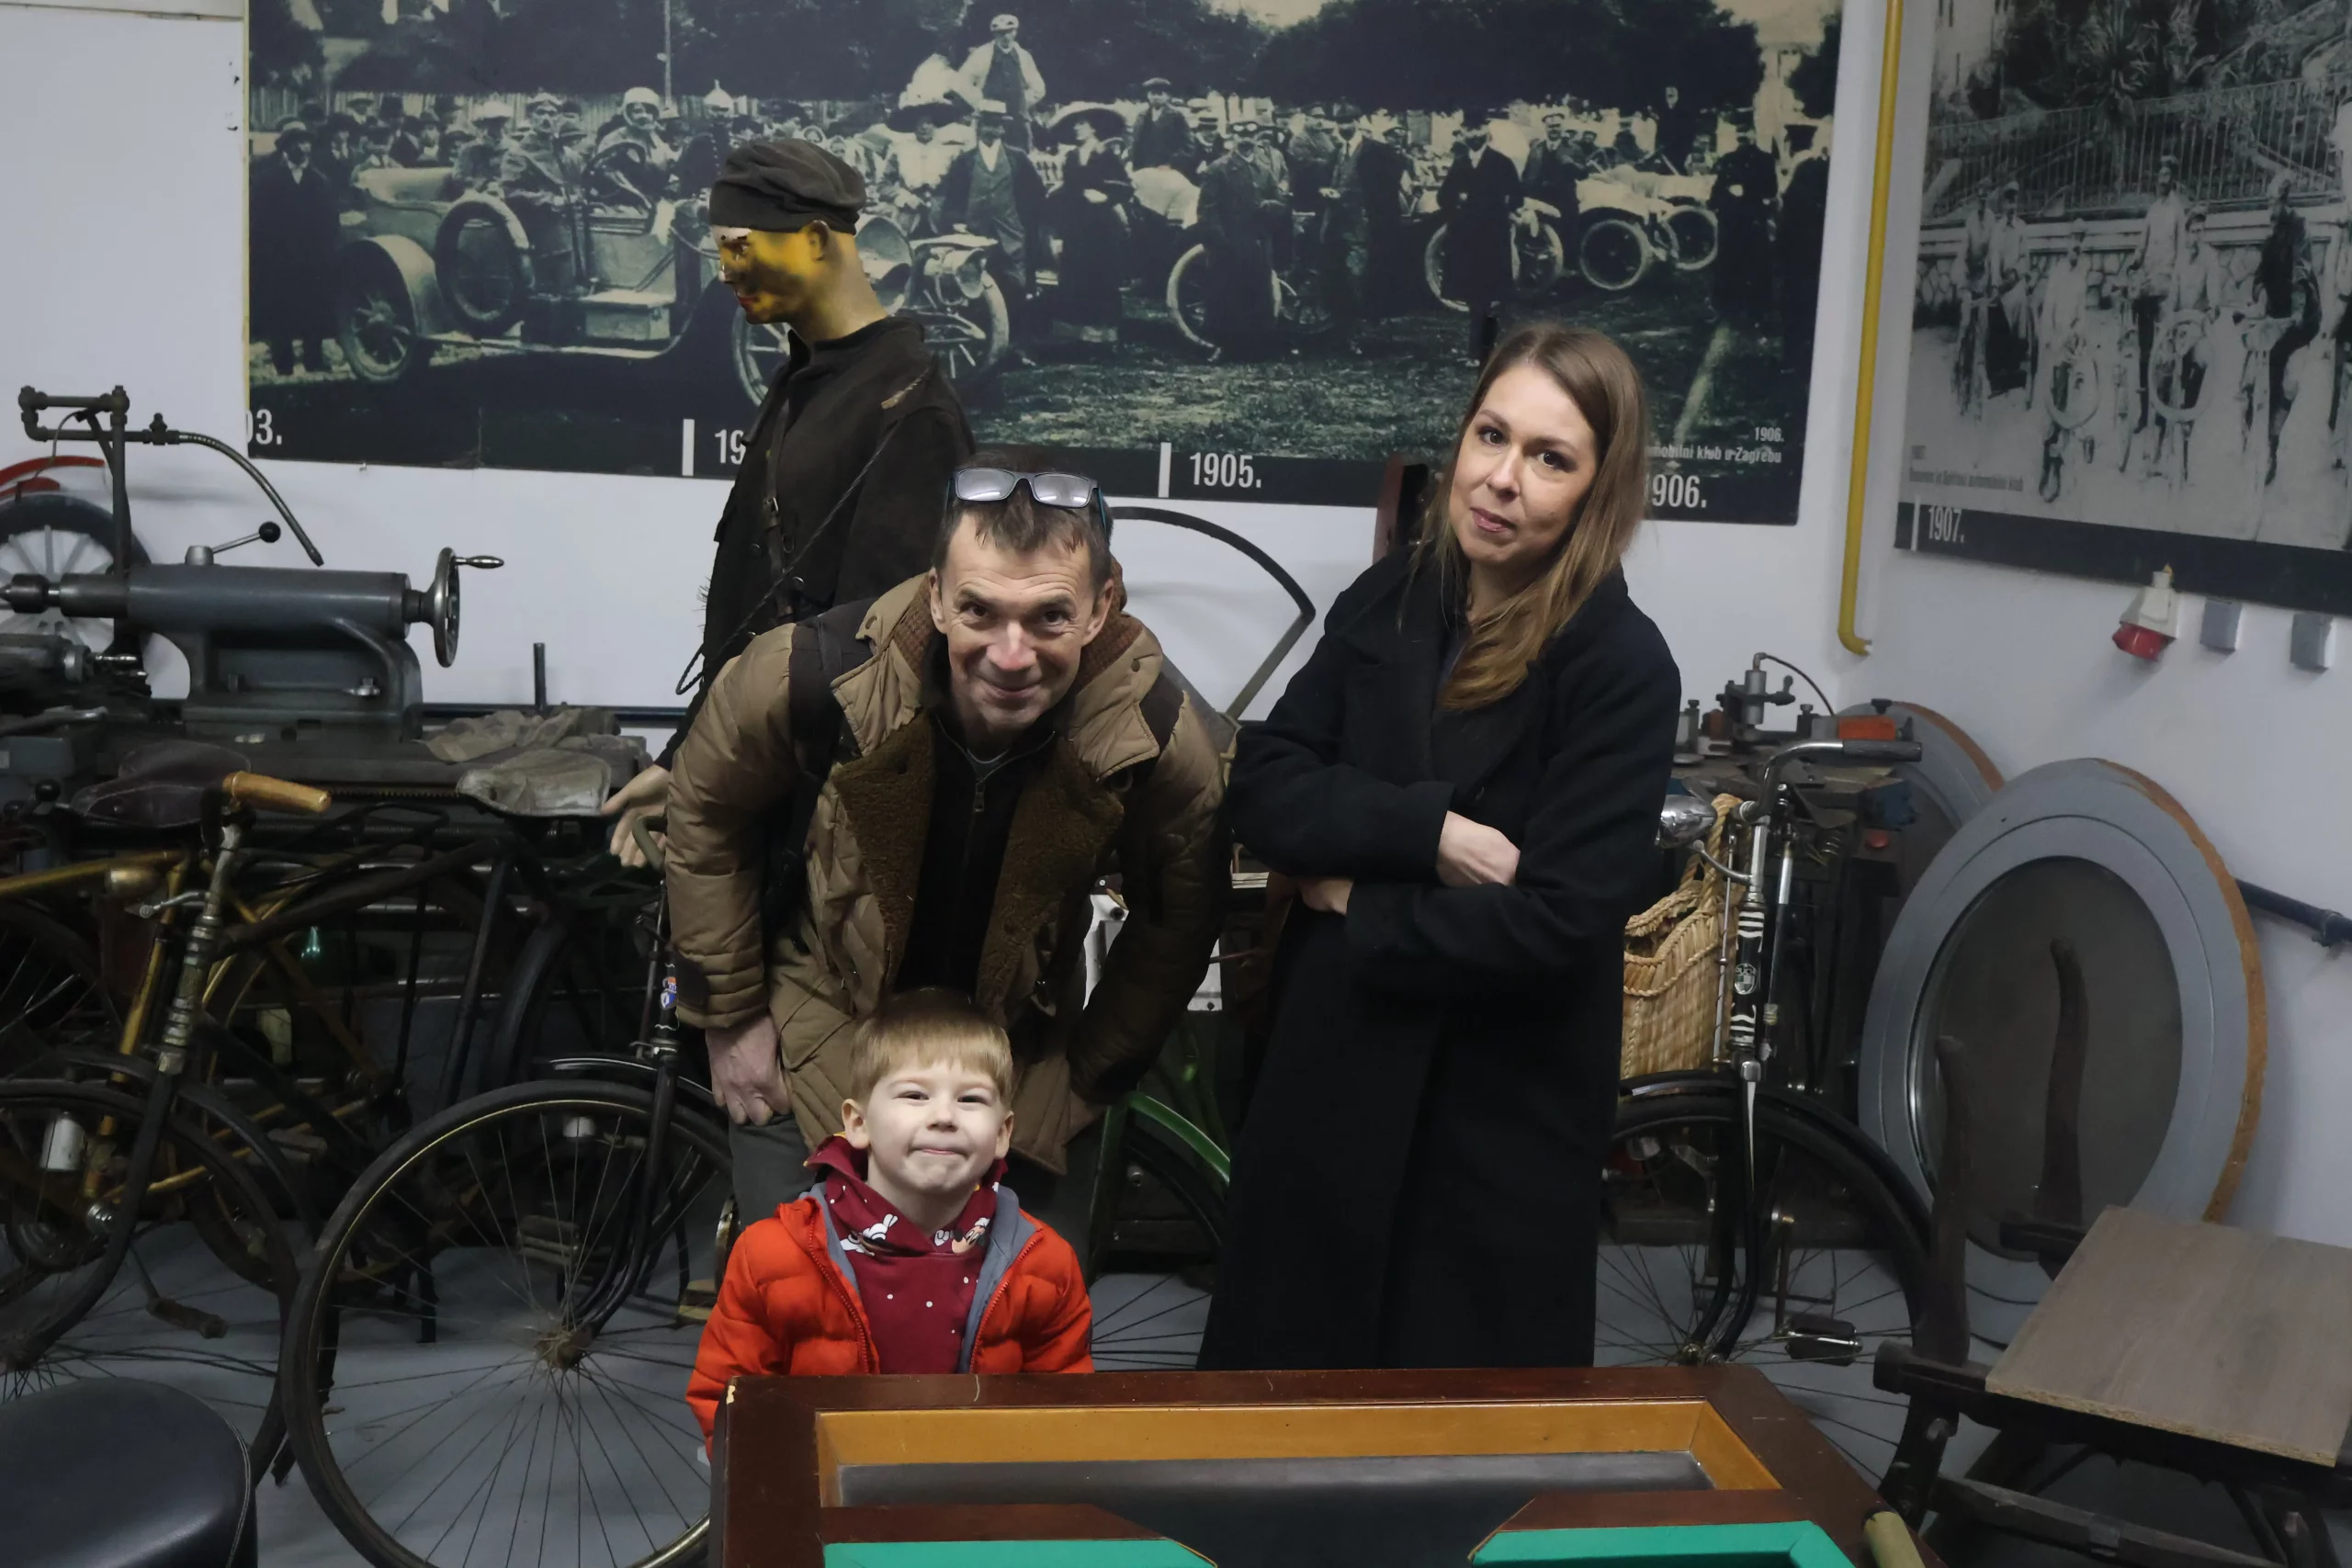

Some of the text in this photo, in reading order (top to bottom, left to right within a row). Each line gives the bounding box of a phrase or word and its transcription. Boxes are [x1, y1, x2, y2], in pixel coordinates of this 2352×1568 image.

[715, 429, 747, 466] 19
[1755, 426, 1784, 442] 1906.
[1189, 452, 1261, 488] 1905.
[1696, 446, 1722, 460] klub
[1735, 446, 1782, 464] Zagrebu
[1928, 506, 1965, 544] 1907.
